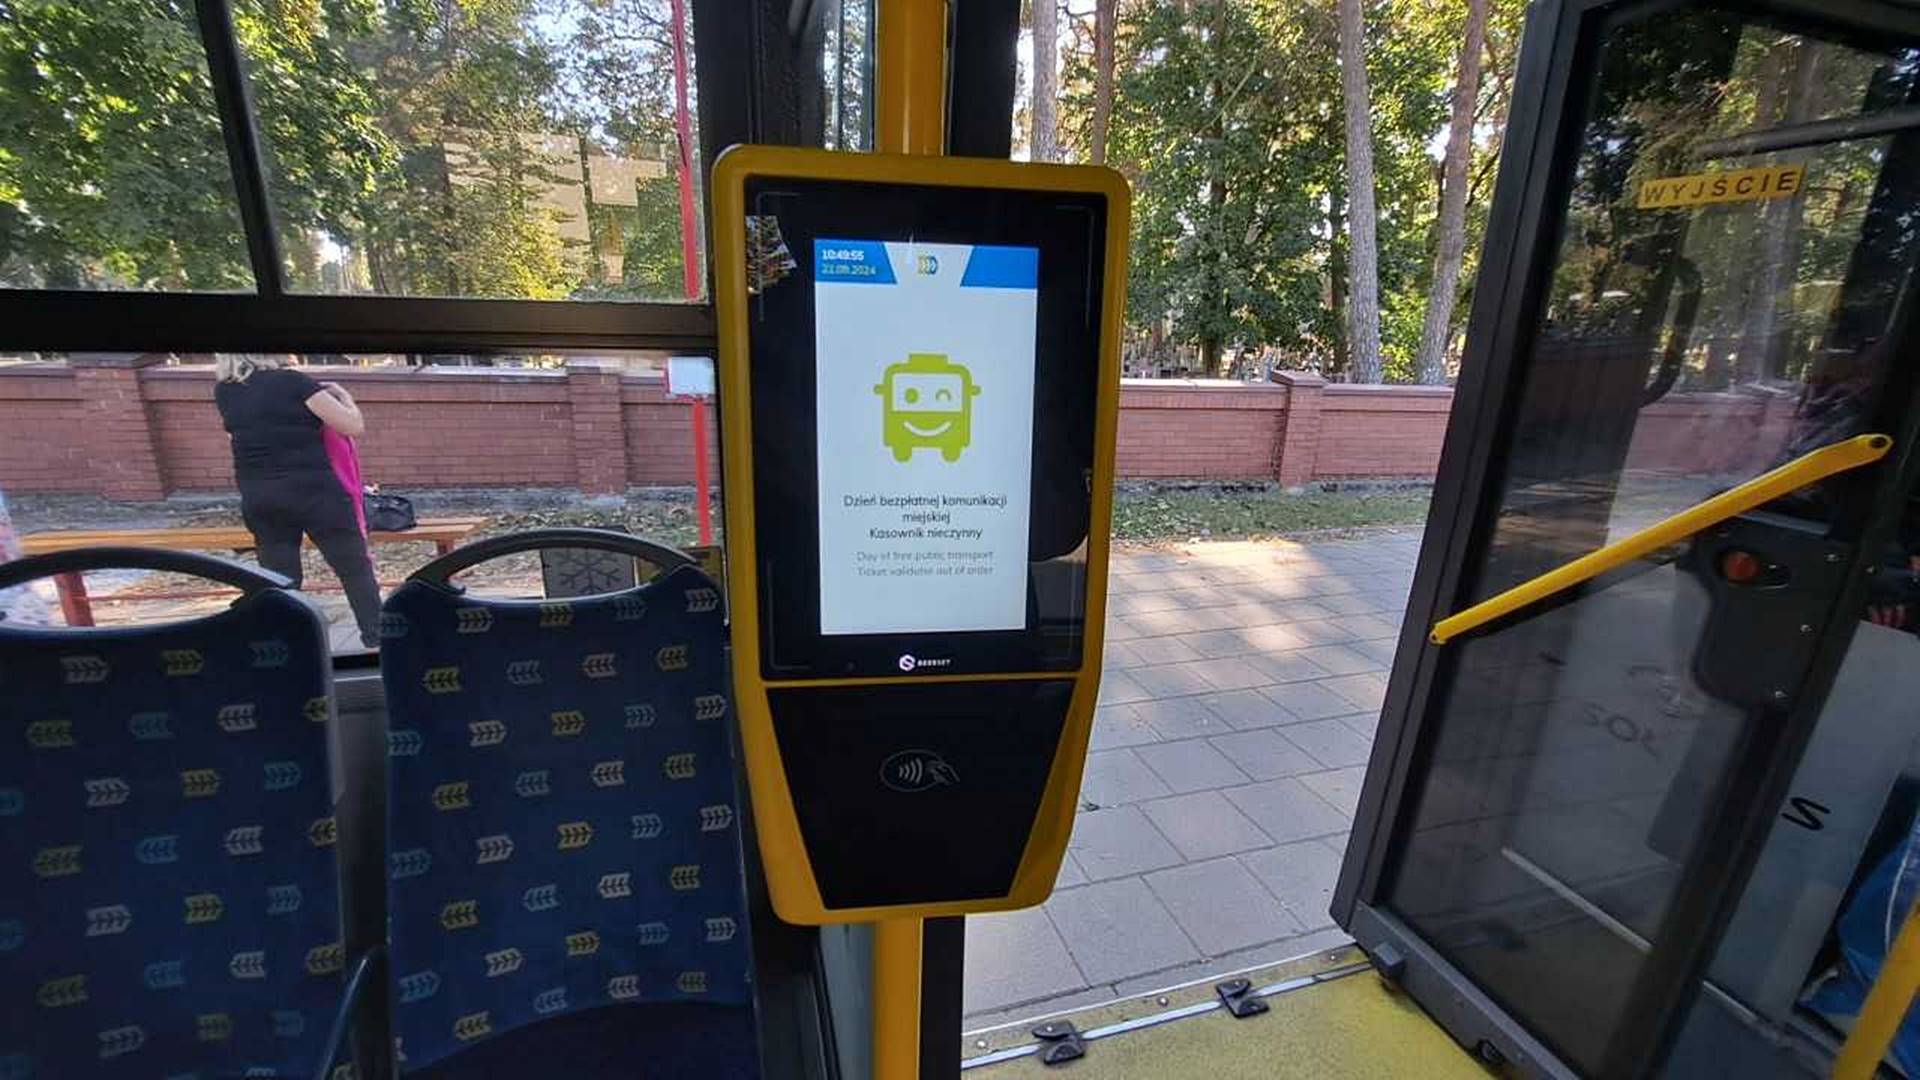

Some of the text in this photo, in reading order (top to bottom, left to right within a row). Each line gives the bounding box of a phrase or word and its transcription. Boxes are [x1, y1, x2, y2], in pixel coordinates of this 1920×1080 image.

[1644, 171, 1796, 203] WYJŚCIE
[843, 494, 1008, 510] Dzień bezpłatnej komunikacji
[902, 511, 951, 524] miejskiej
[869, 527, 983, 541] Kasownik nieczynny
